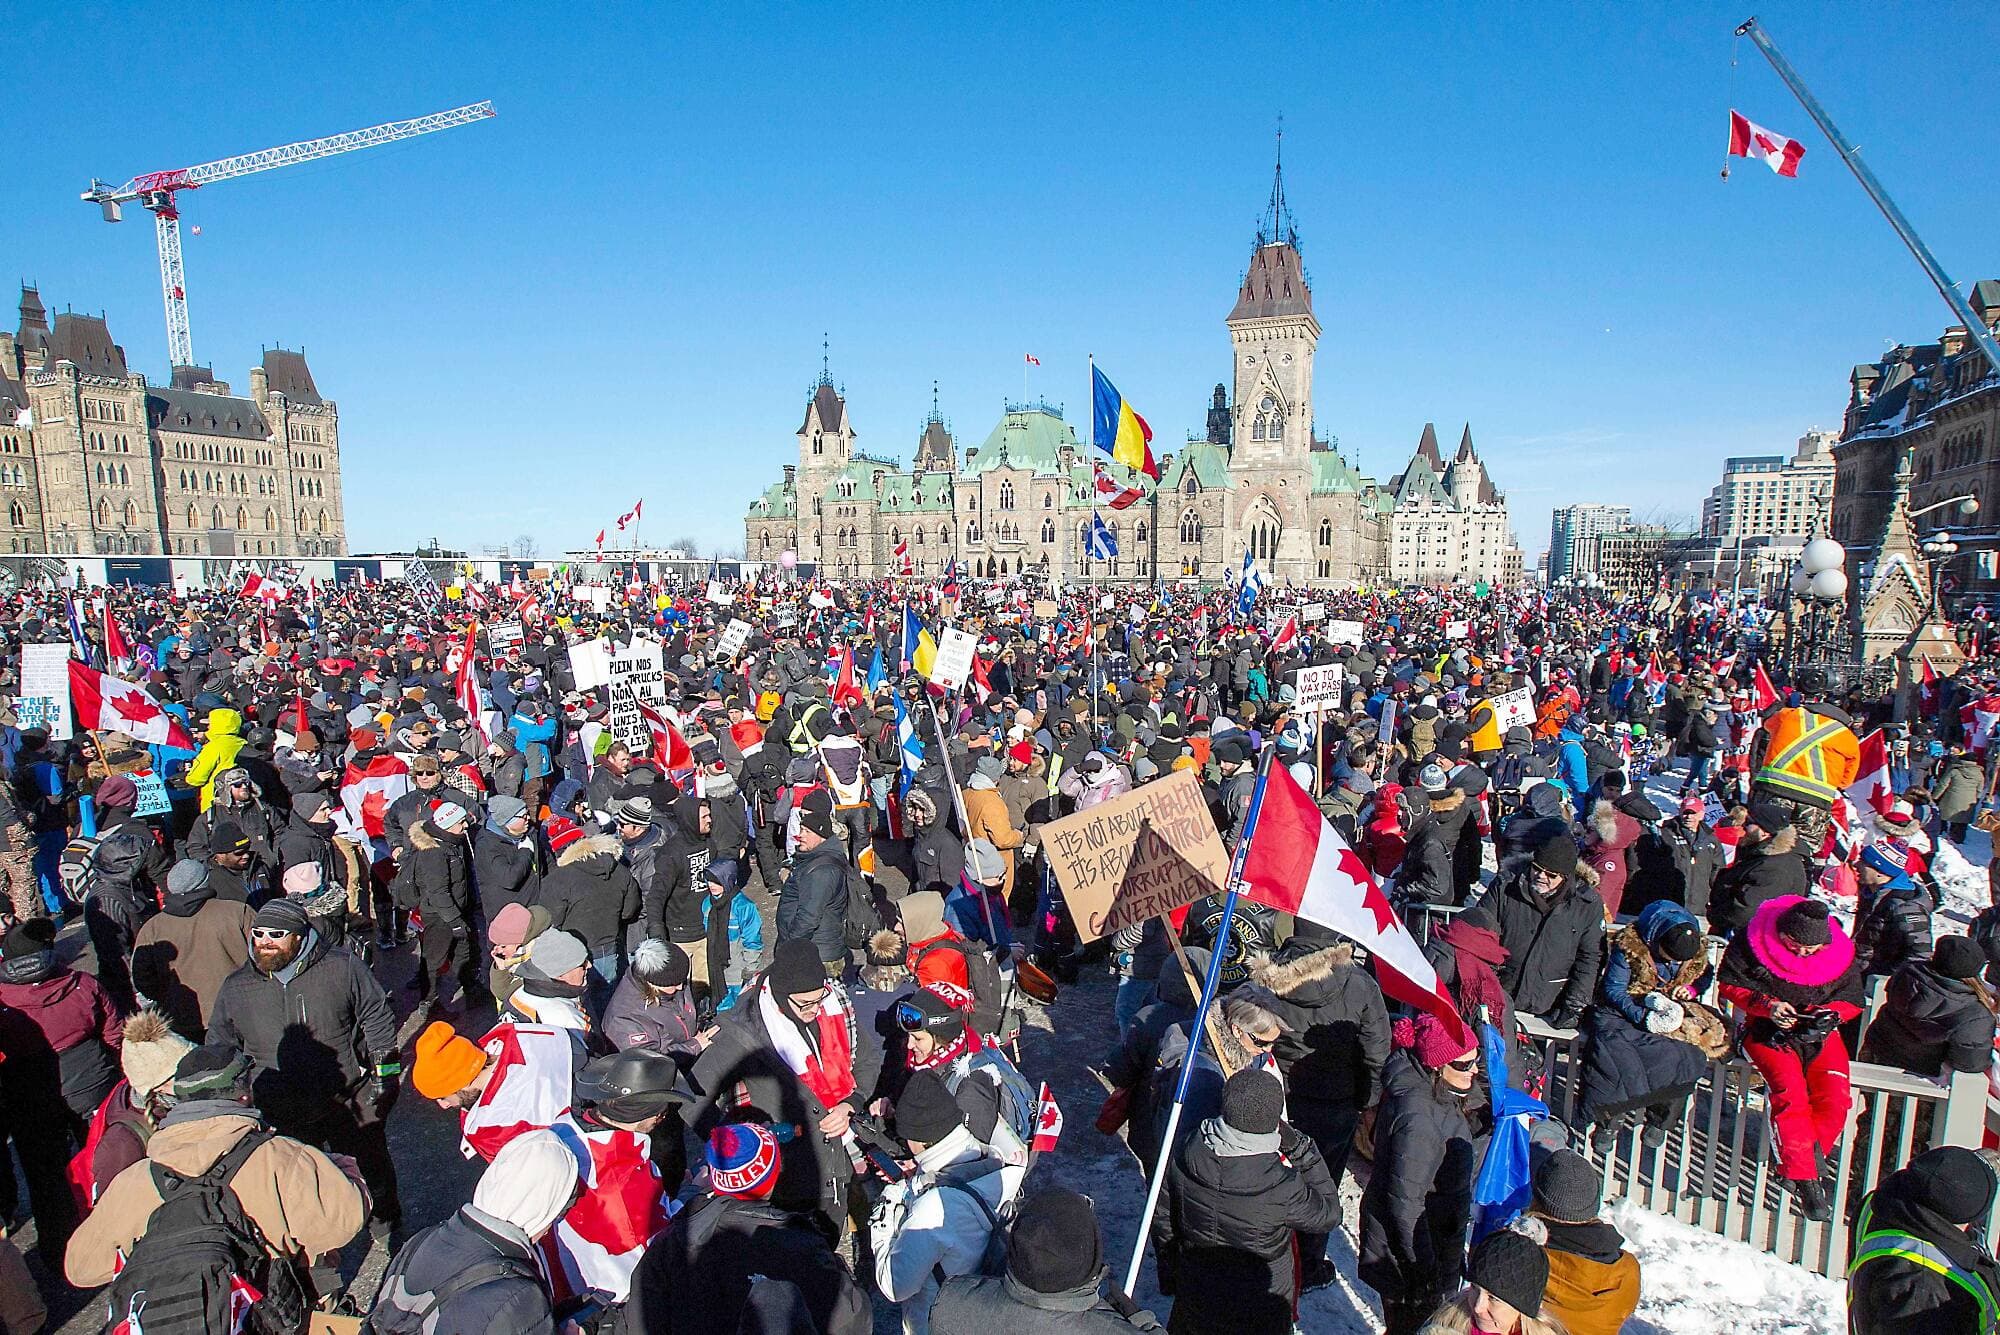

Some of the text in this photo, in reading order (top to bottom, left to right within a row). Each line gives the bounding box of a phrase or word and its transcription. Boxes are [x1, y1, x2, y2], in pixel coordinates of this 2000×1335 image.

[609, 658, 651, 674] PLEIN NOS
[628, 671, 662, 685] TRUCKS
[1303, 669, 1333, 683] NO TO
[640, 684, 651, 698] AU
[1300, 679, 1340, 694] VAX PASS
[16, 697, 53, 706] TRUE
[1300, 691, 1339, 705] & MANDATES
[1494, 689, 1526, 708] STRONG
[17, 705, 60, 714] NORTH
[17, 714, 59, 723] STRONG
[614, 714, 638, 727] UNIS
[1506, 713, 1527, 728] FREE
[614, 727, 629, 739] NOS
[631, 736, 647, 747] LIB
[139, 793, 158, 801] OUS
[138, 801, 170, 811] SEMBLE
[1083, 816, 1109, 851] NOT
[1108, 802, 1147, 841] ABOUT
[1148, 780, 1205, 823] HEALTH
[1100, 835, 1146, 881] ABOUT
[1150, 814, 1215, 861] CONTROL
[1113, 857, 1184, 901] CORRUPT
[1089, 861, 1219, 936] GOVERNMENT
[1206, 914, 1256, 941] VETRANS
[713, 1155, 768, 1188] RIGLEY
